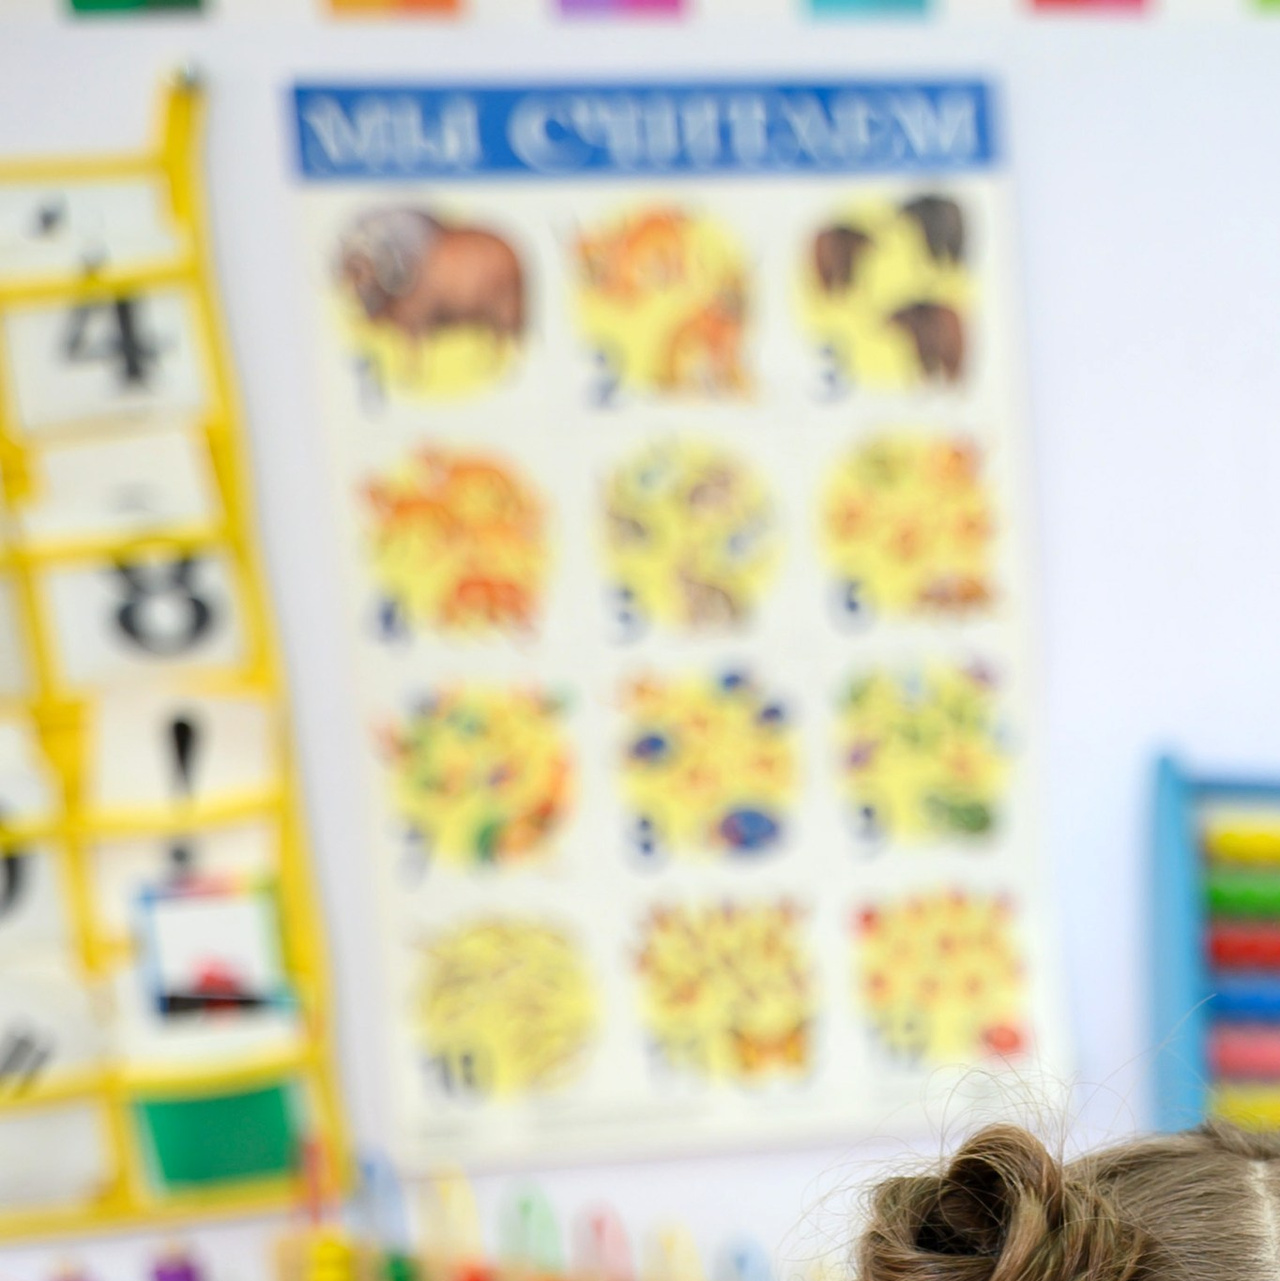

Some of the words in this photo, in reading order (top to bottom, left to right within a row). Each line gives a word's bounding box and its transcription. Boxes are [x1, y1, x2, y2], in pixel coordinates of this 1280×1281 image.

[303, 95, 482, 173] МЫ
[508, 90, 978, 173] СЧИТАЕМ
[58, 255, 175, 386] 4
